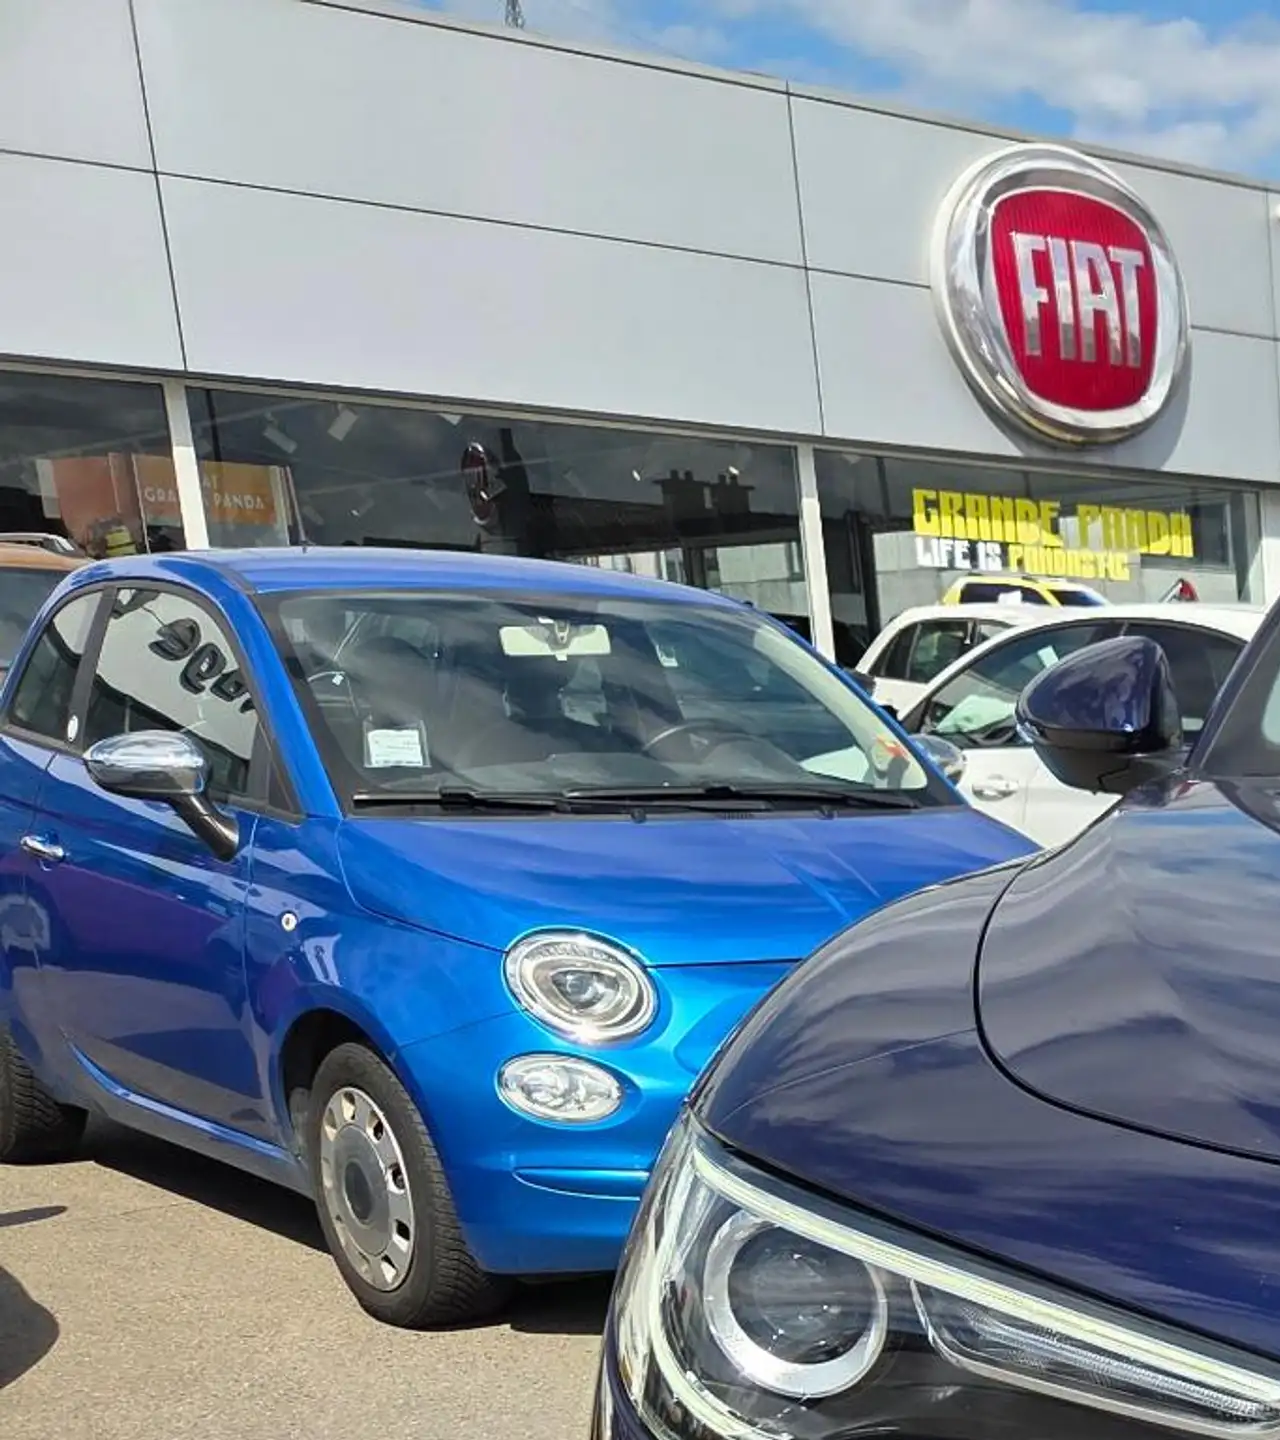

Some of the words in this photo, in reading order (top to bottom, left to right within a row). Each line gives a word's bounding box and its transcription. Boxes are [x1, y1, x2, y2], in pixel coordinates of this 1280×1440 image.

[1009, 231, 1145, 367] FIAT
[213, 492, 264, 509] PANDA
[912, 488, 1064, 547] GRANDE
[1077, 503, 1193, 557] PANDA
[915, 537, 972, 569] LIFE
[977, 540, 1002, 571] IS
